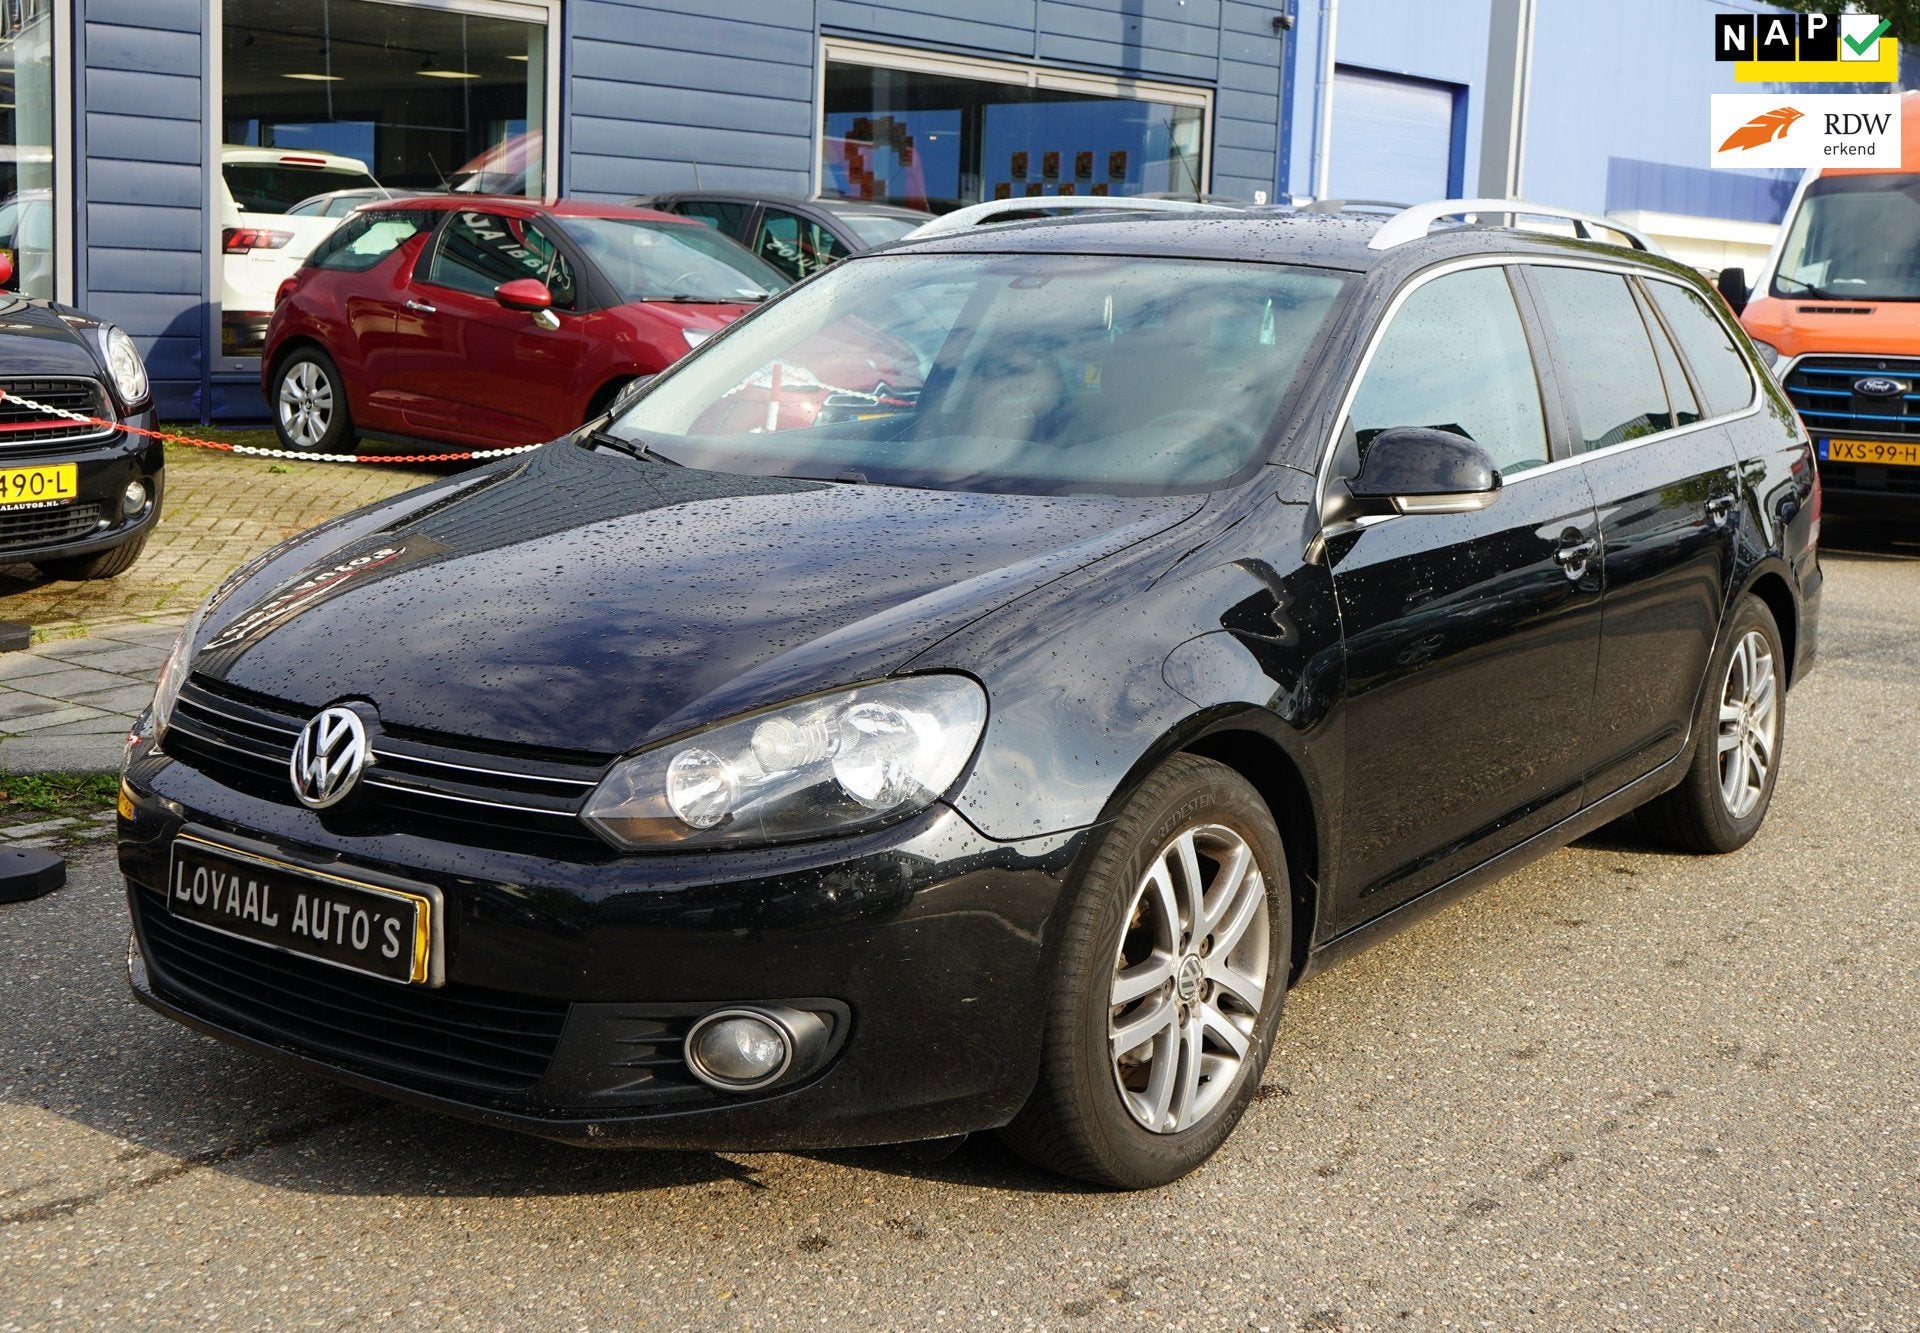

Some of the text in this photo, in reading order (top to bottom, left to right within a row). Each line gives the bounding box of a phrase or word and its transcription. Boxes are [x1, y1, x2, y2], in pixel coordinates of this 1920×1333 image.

[1833, 442, 1917, 462] VXS-99-H
[176, 860, 401, 959] LOYAAL AUTO'S
